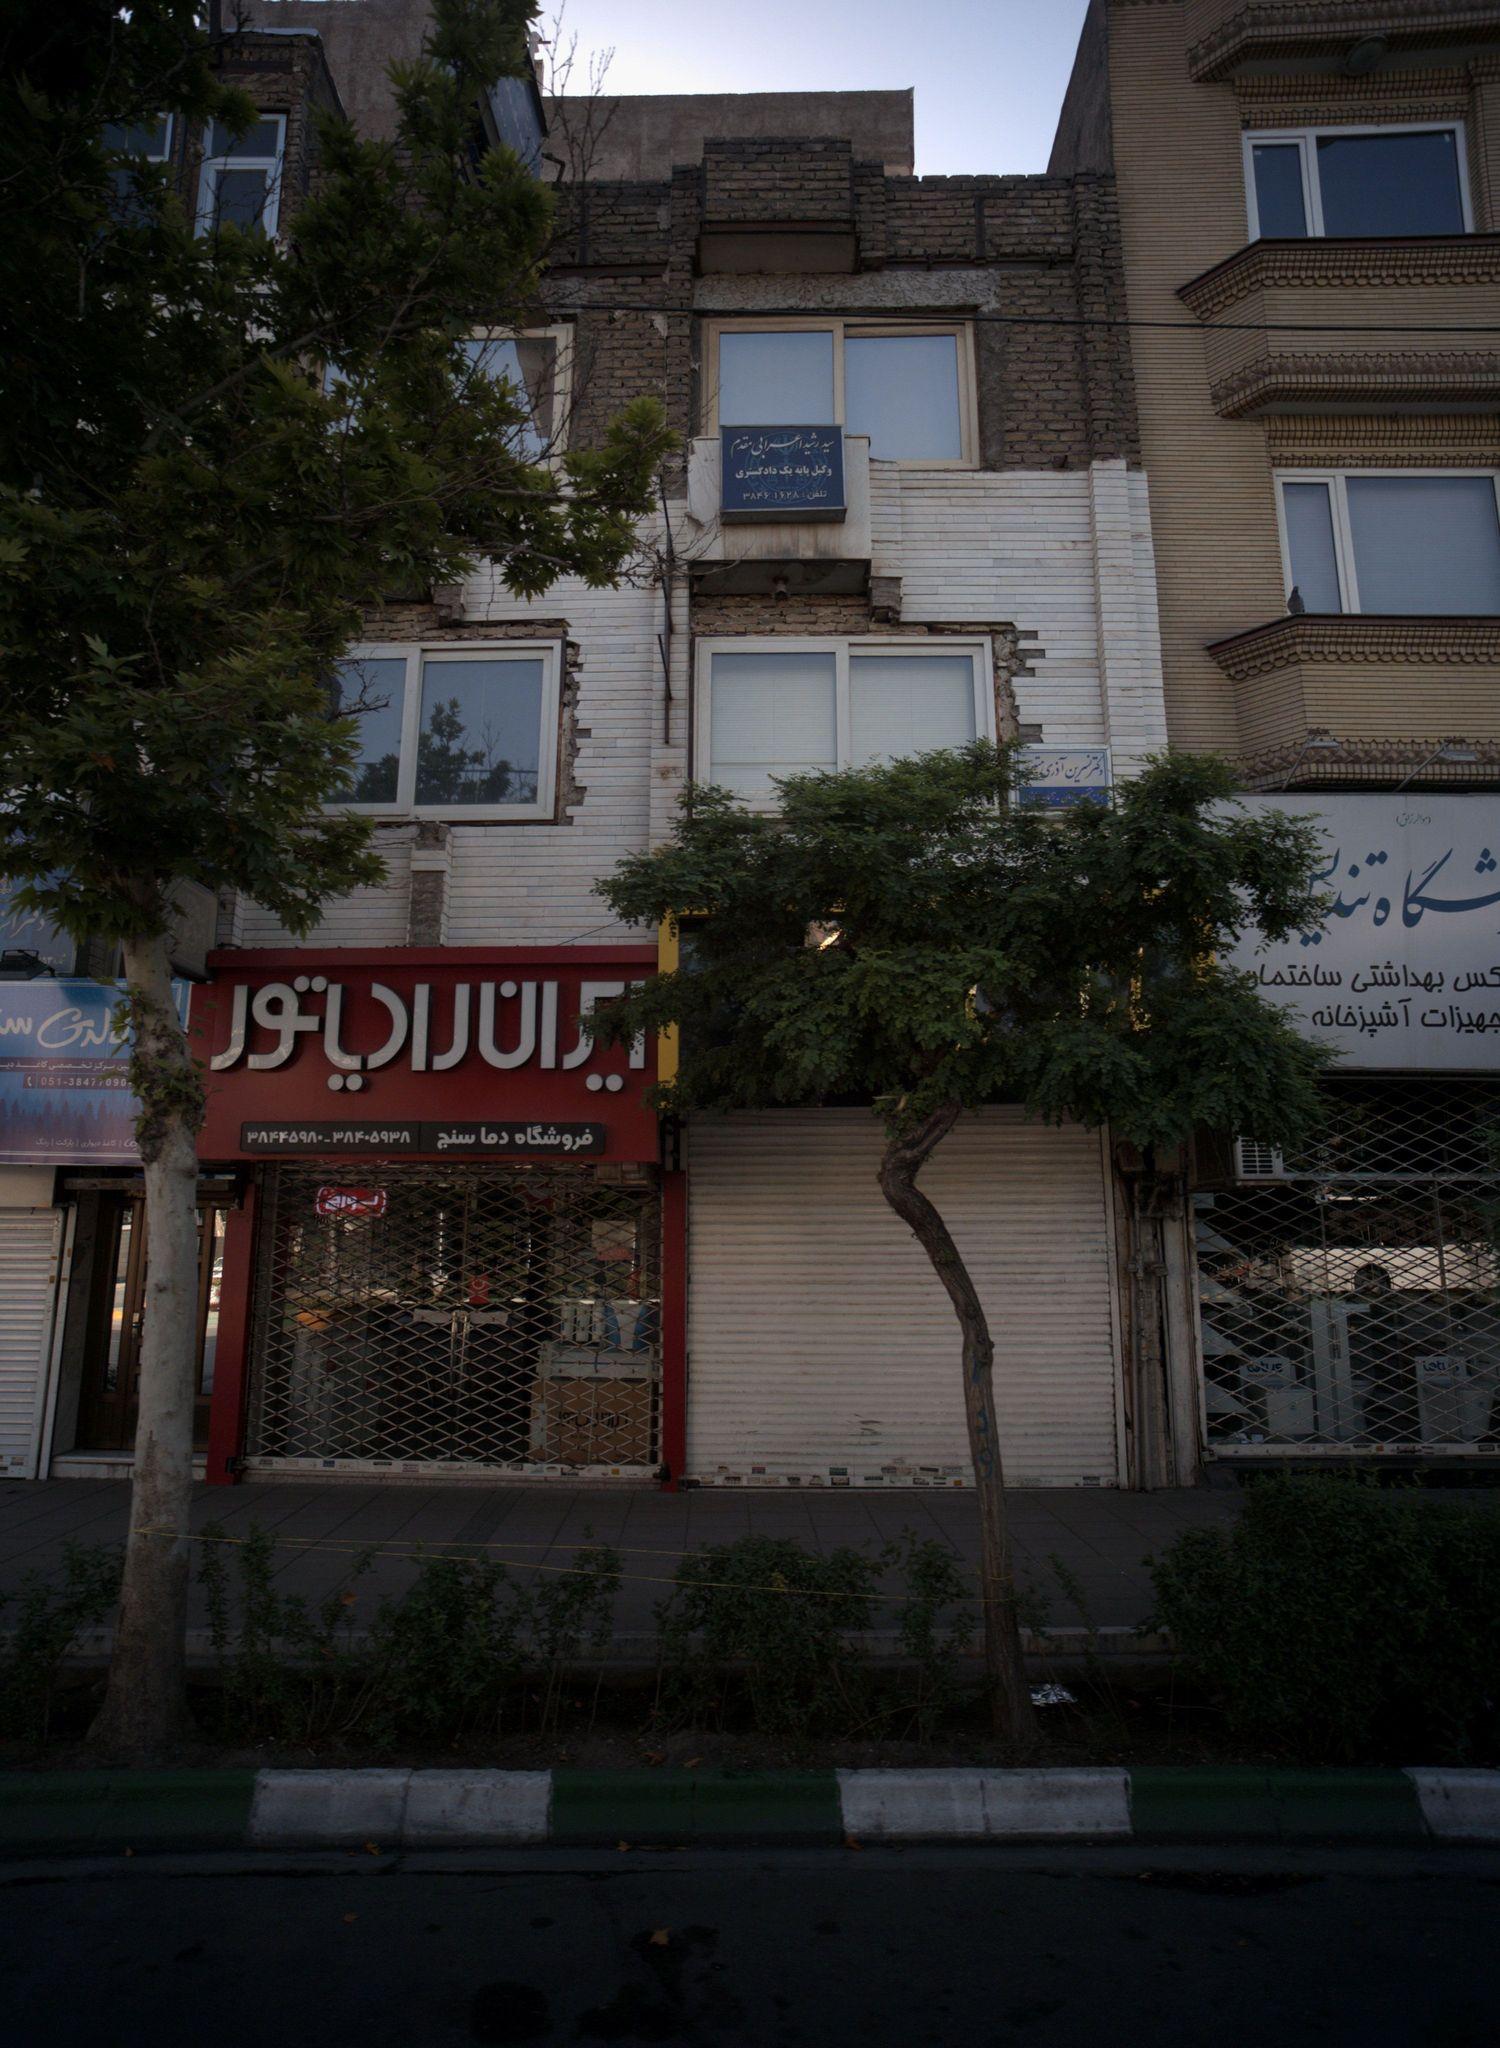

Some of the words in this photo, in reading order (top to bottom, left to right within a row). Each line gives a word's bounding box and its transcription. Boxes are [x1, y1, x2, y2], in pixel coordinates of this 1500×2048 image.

[730, 436, 753, 459] مقدم
[802, 432, 819, 455] رشید
[735, 465, 778, 479] دادگستری
[779, 466, 793, 477] یک
[794, 465, 810, 477] پایه
[811, 465, 833, 477] وکیل
[1065, 754, 1092, 783] نسرین
[1086, 755, 1105, 779] دکتر
[1373, 847, 1500, 929] شگاه
[1351, 961, 1445, 993] بهداشتی
[1453, 967, 1500, 991] کس
[1312, 998, 1412, 1038] آشپزخانه
[1421, 1005, 1500, 1034] جهیزات
[209, 975, 471, 1092] رادیاتور
[436, 1129, 477, 1150] سنج
[480, 1126, 510, 1146] دما
[514, 1125, 594, 1151] فروشگاه
